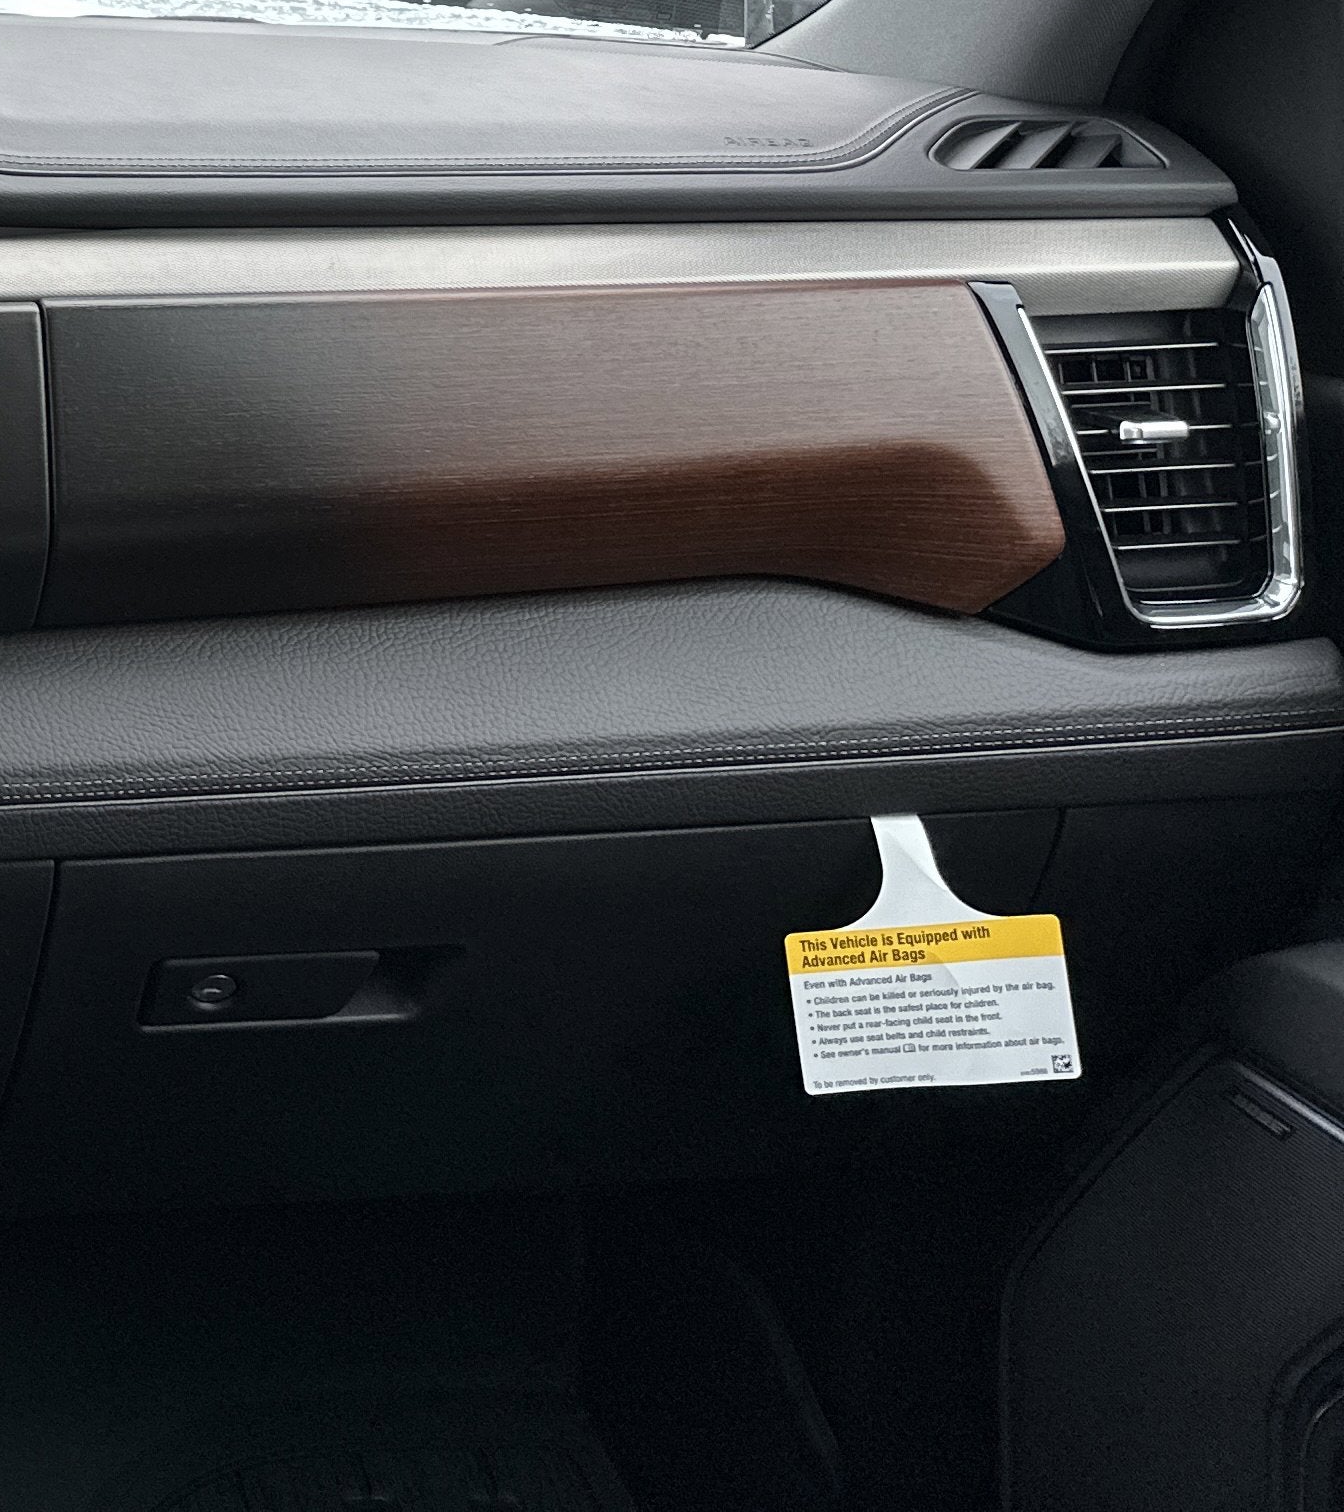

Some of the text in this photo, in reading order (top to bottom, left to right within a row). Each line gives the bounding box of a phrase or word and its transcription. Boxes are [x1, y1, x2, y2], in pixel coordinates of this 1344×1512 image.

[799, 926, 991, 952] This Vehicle is Equipped with
[802, 948, 926, 968] Advanced Air Bags
[804, 973, 932, 990] Even with Advanced Air Bags
[813, 995, 850, 1006] Children
[851, 994, 868, 1003] can
[869, 993, 880, 1002] be
[882, 990, 906, 1000] killed
[907, 990, 917, 998] or
[919, 986, 959, 998] seriously
[962, 984, 991, 996] injured
[992, 984, 1003, 993] by
[1005, 983, 1020, 991] the
[1022, 981, 1033, 990] air
[815, 999, 1000, 1019] The back seat is the safest place for children.
[816, 1023, 841, 1032] Never
[843, 1021, 856, 1031] put
[865, 1017, 911, 1028] rear-facing
[912, 1016, 933, 1025] child
[935, 1015, 954, 1024] seat
[955, 1014, 963, 1023] in
[965, 1014, 979, 1023] the
[819, 1036, 848, 1046] Always
[849, 1035, 864, 1043] use
[866, 1033, 884, 1042] seat
[885, 1031, 906, 1041] belts
[908, 1030, 923, 1039] and
[925, 1029, 947, 1038] child
[820, 1050, 836, 1060] See
[871, 1045, 901, 1055] manual
[918, 1044, 929, 1052] for
[931, 1042, 953, 1051] more
[955, 1040, 1002, 1050] information
[1004, 1038, 1027, 1048] about
[1029, 1037, 1039, 1046] air
[813, 1073, 936, 1089] To be removed by customer only.
